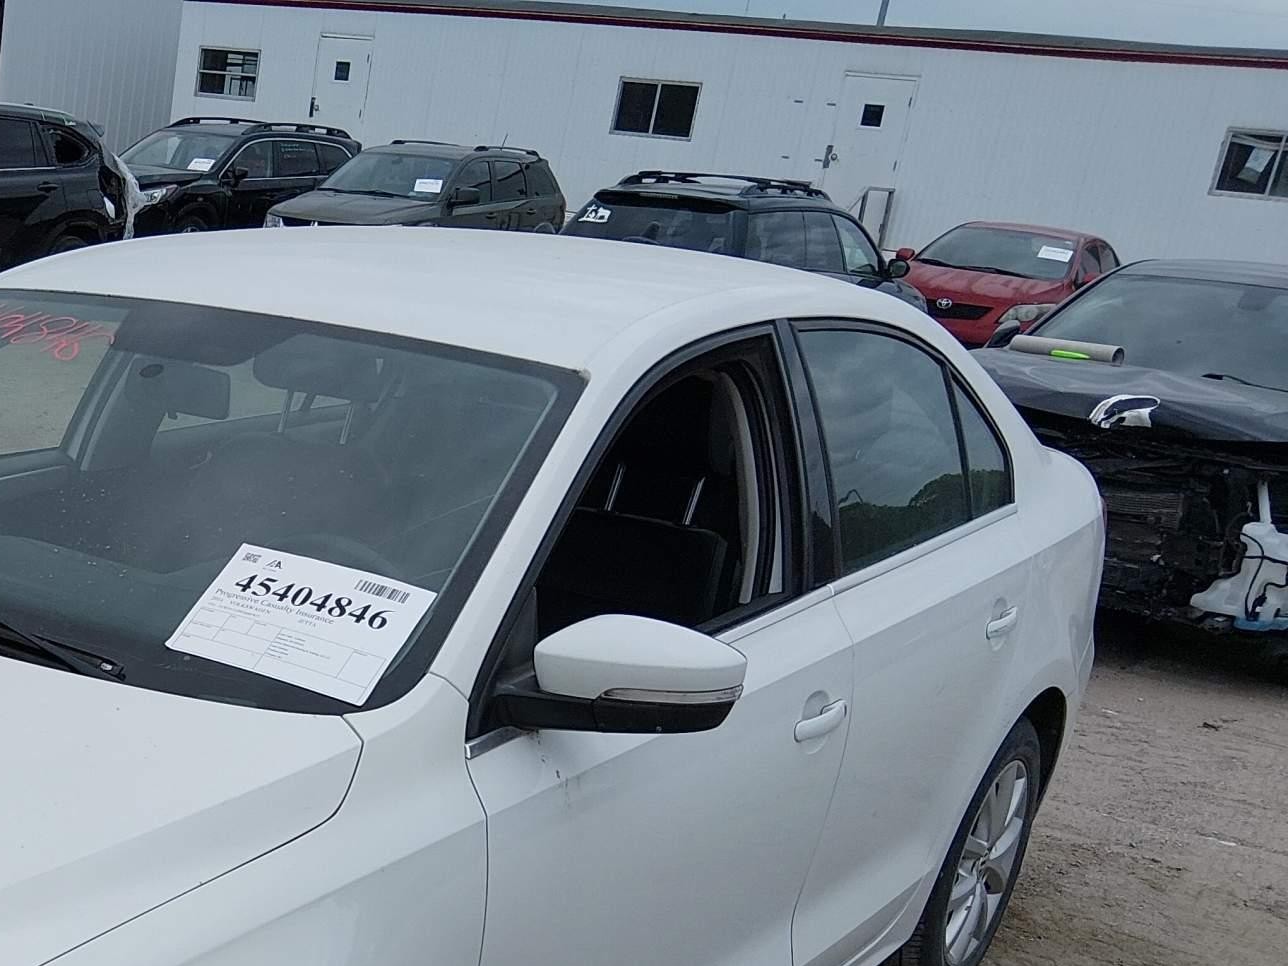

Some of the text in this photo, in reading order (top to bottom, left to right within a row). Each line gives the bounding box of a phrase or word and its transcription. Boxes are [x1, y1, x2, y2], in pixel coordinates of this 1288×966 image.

[215, 588, 259, 605] Progressive
[260, 599, 293, 614] Casualty
[295, 608, 335, 625] Insurance
[235, 574, 396, 630] 45404846
